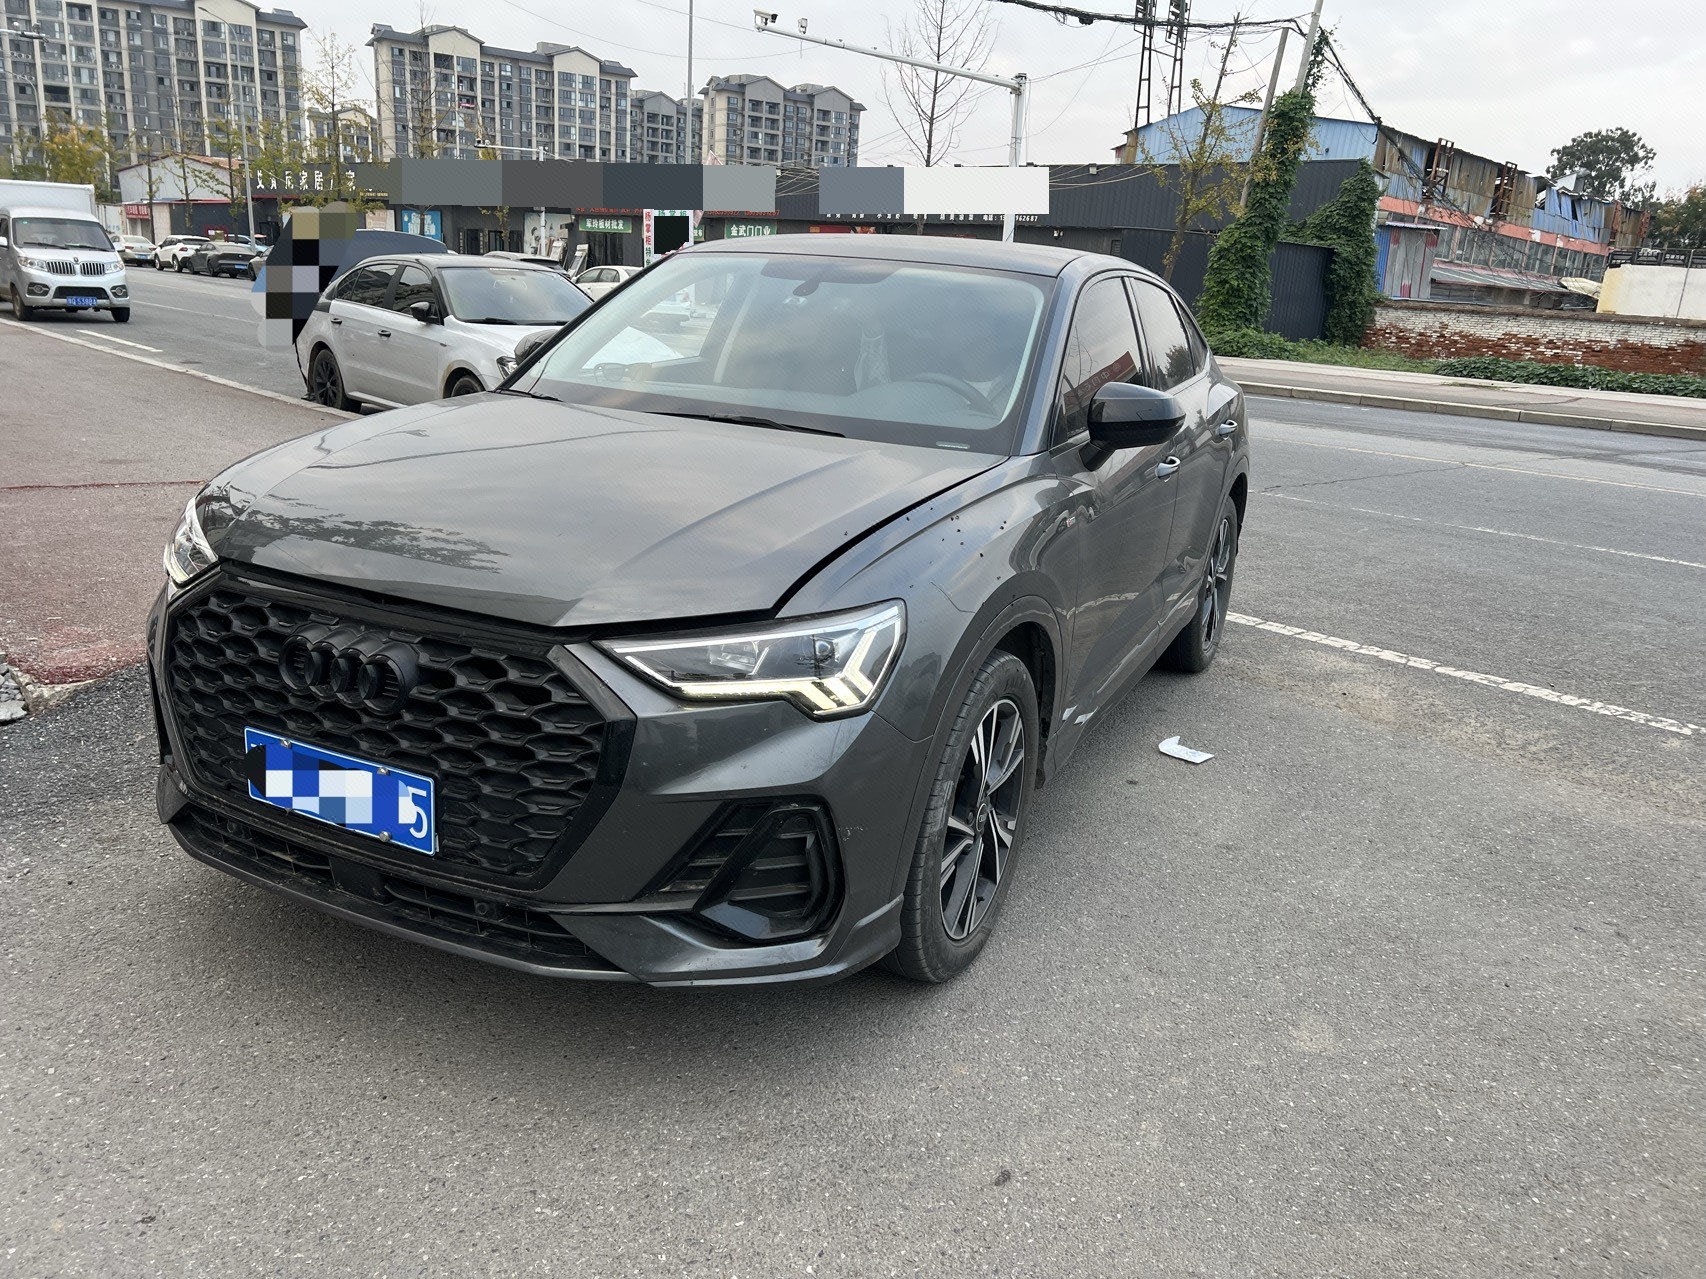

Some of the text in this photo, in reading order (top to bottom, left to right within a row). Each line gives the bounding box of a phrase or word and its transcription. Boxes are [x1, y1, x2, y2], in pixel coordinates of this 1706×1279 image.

[730, 224, 771, 237] 金武门门业
